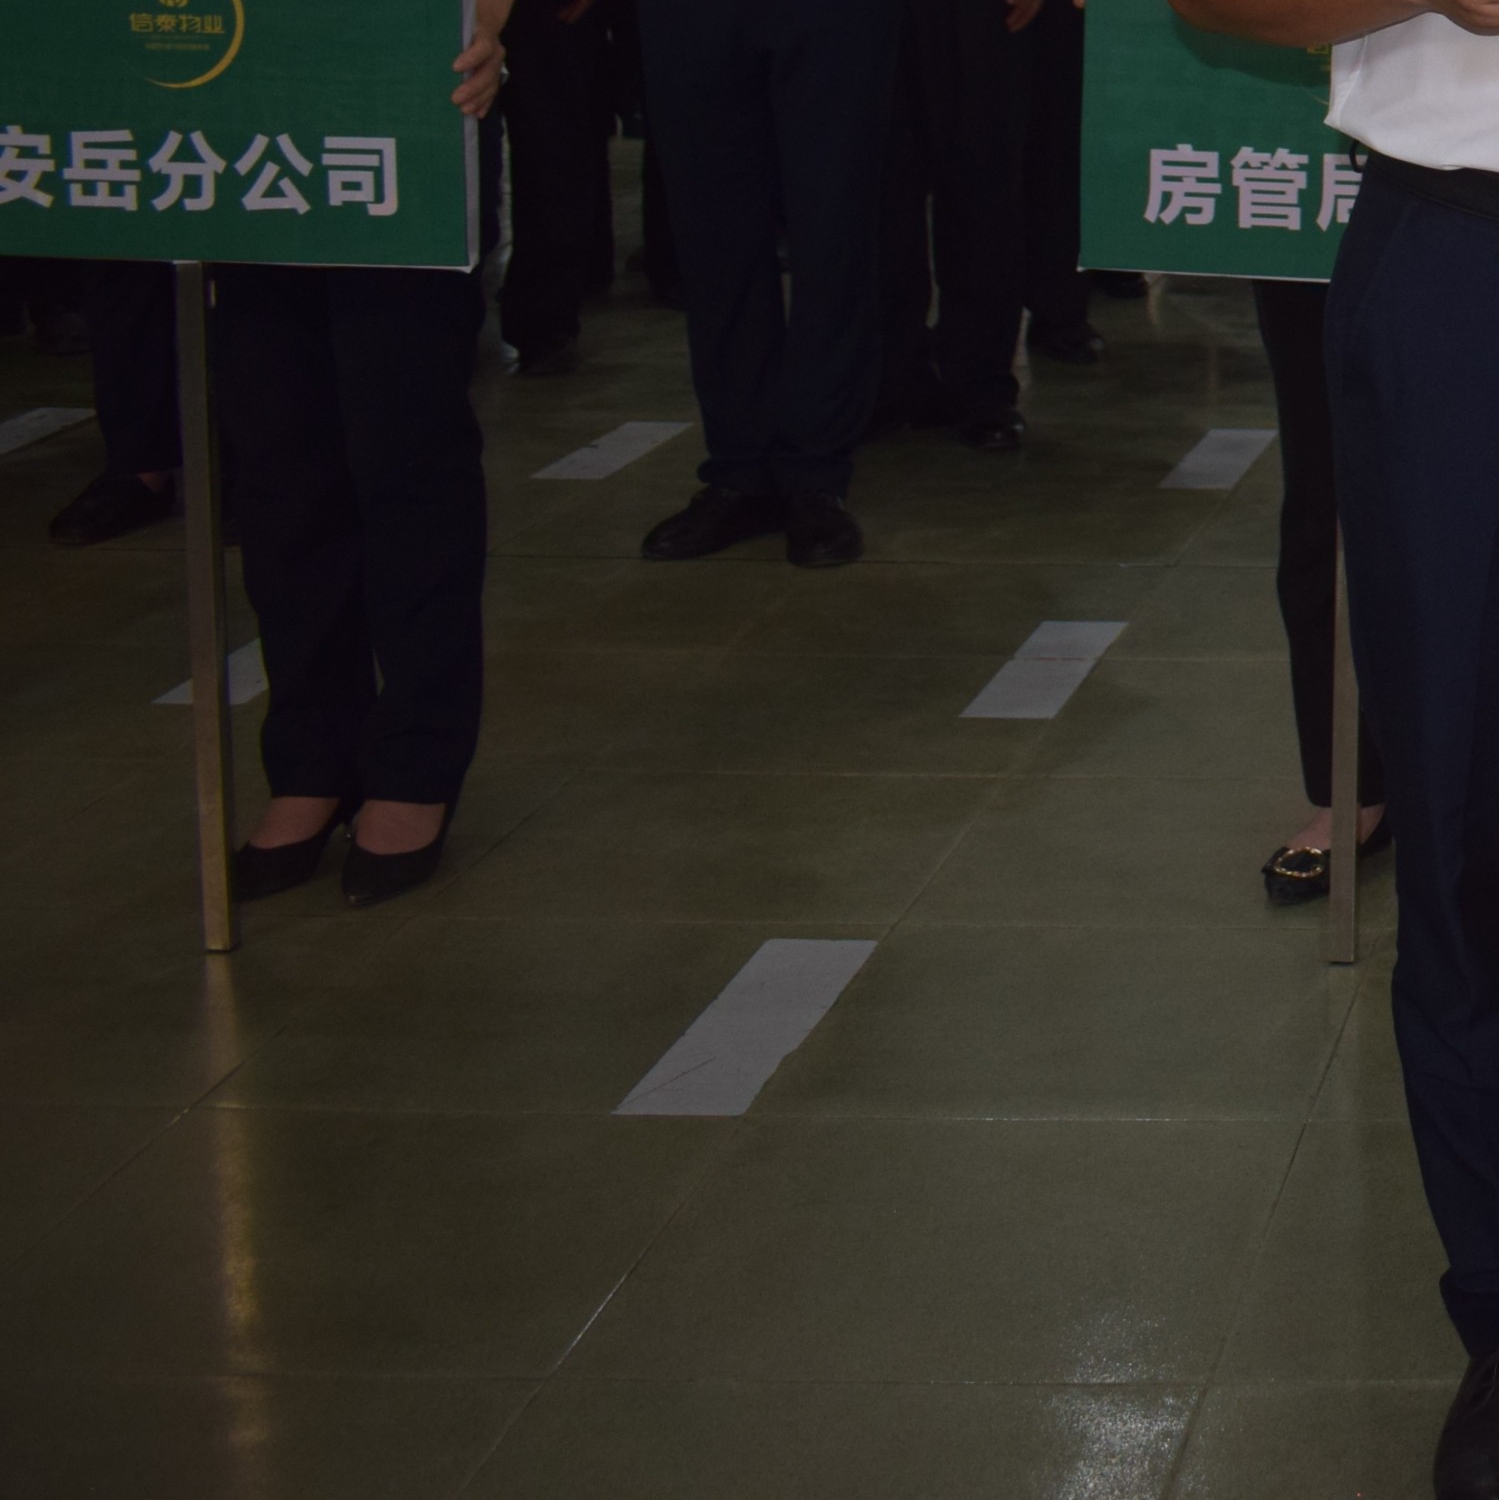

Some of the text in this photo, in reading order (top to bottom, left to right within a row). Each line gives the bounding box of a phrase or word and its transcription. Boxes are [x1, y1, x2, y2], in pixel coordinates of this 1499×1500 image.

[129, 12, 225, 35] 信泰物业
[0, 124, 400, 217] 安岳分公司
